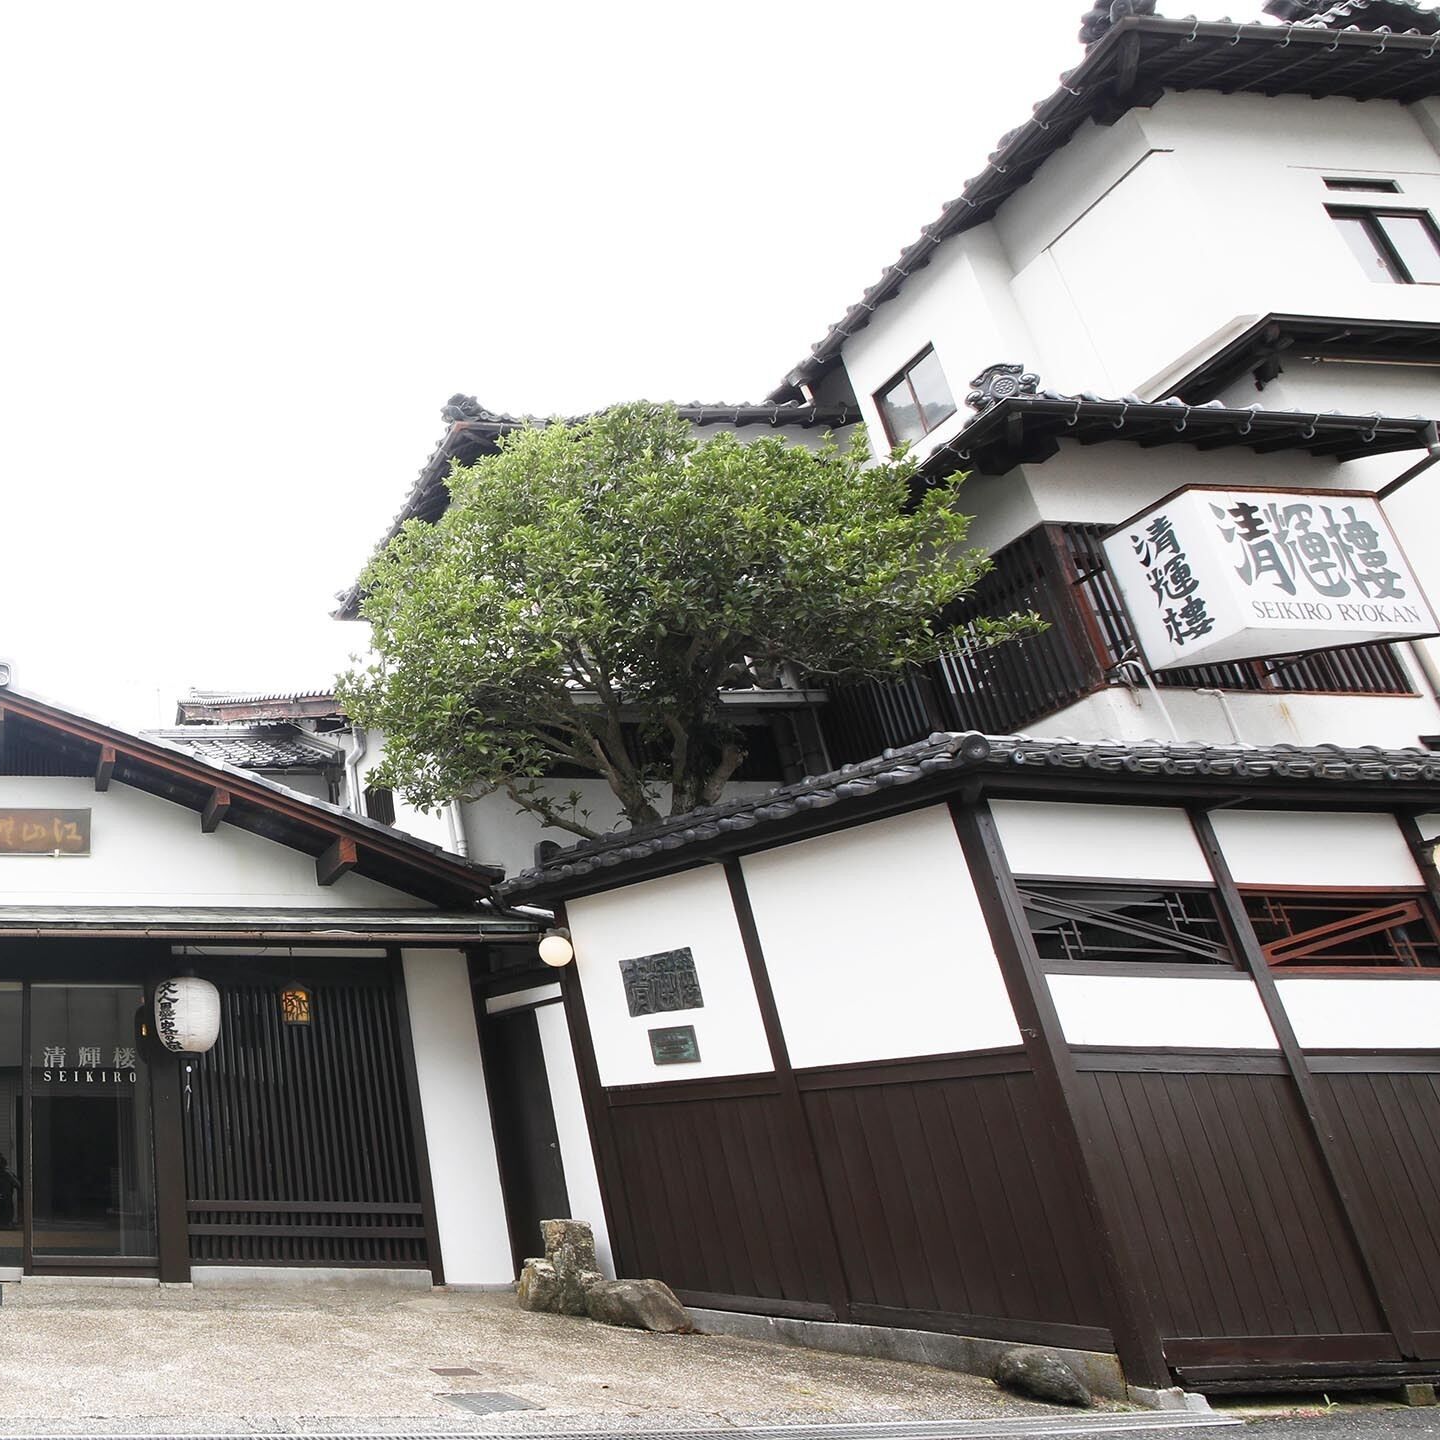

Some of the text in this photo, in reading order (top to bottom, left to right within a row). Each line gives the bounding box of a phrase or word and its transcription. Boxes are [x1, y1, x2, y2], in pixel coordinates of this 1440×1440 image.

[1251, 600, 1421, 624] SEIKIRO RYOKAN
[43, 1046, 136, 1069] 清輝楼
[43, 1070, 137, 1082] SEIKIRO
